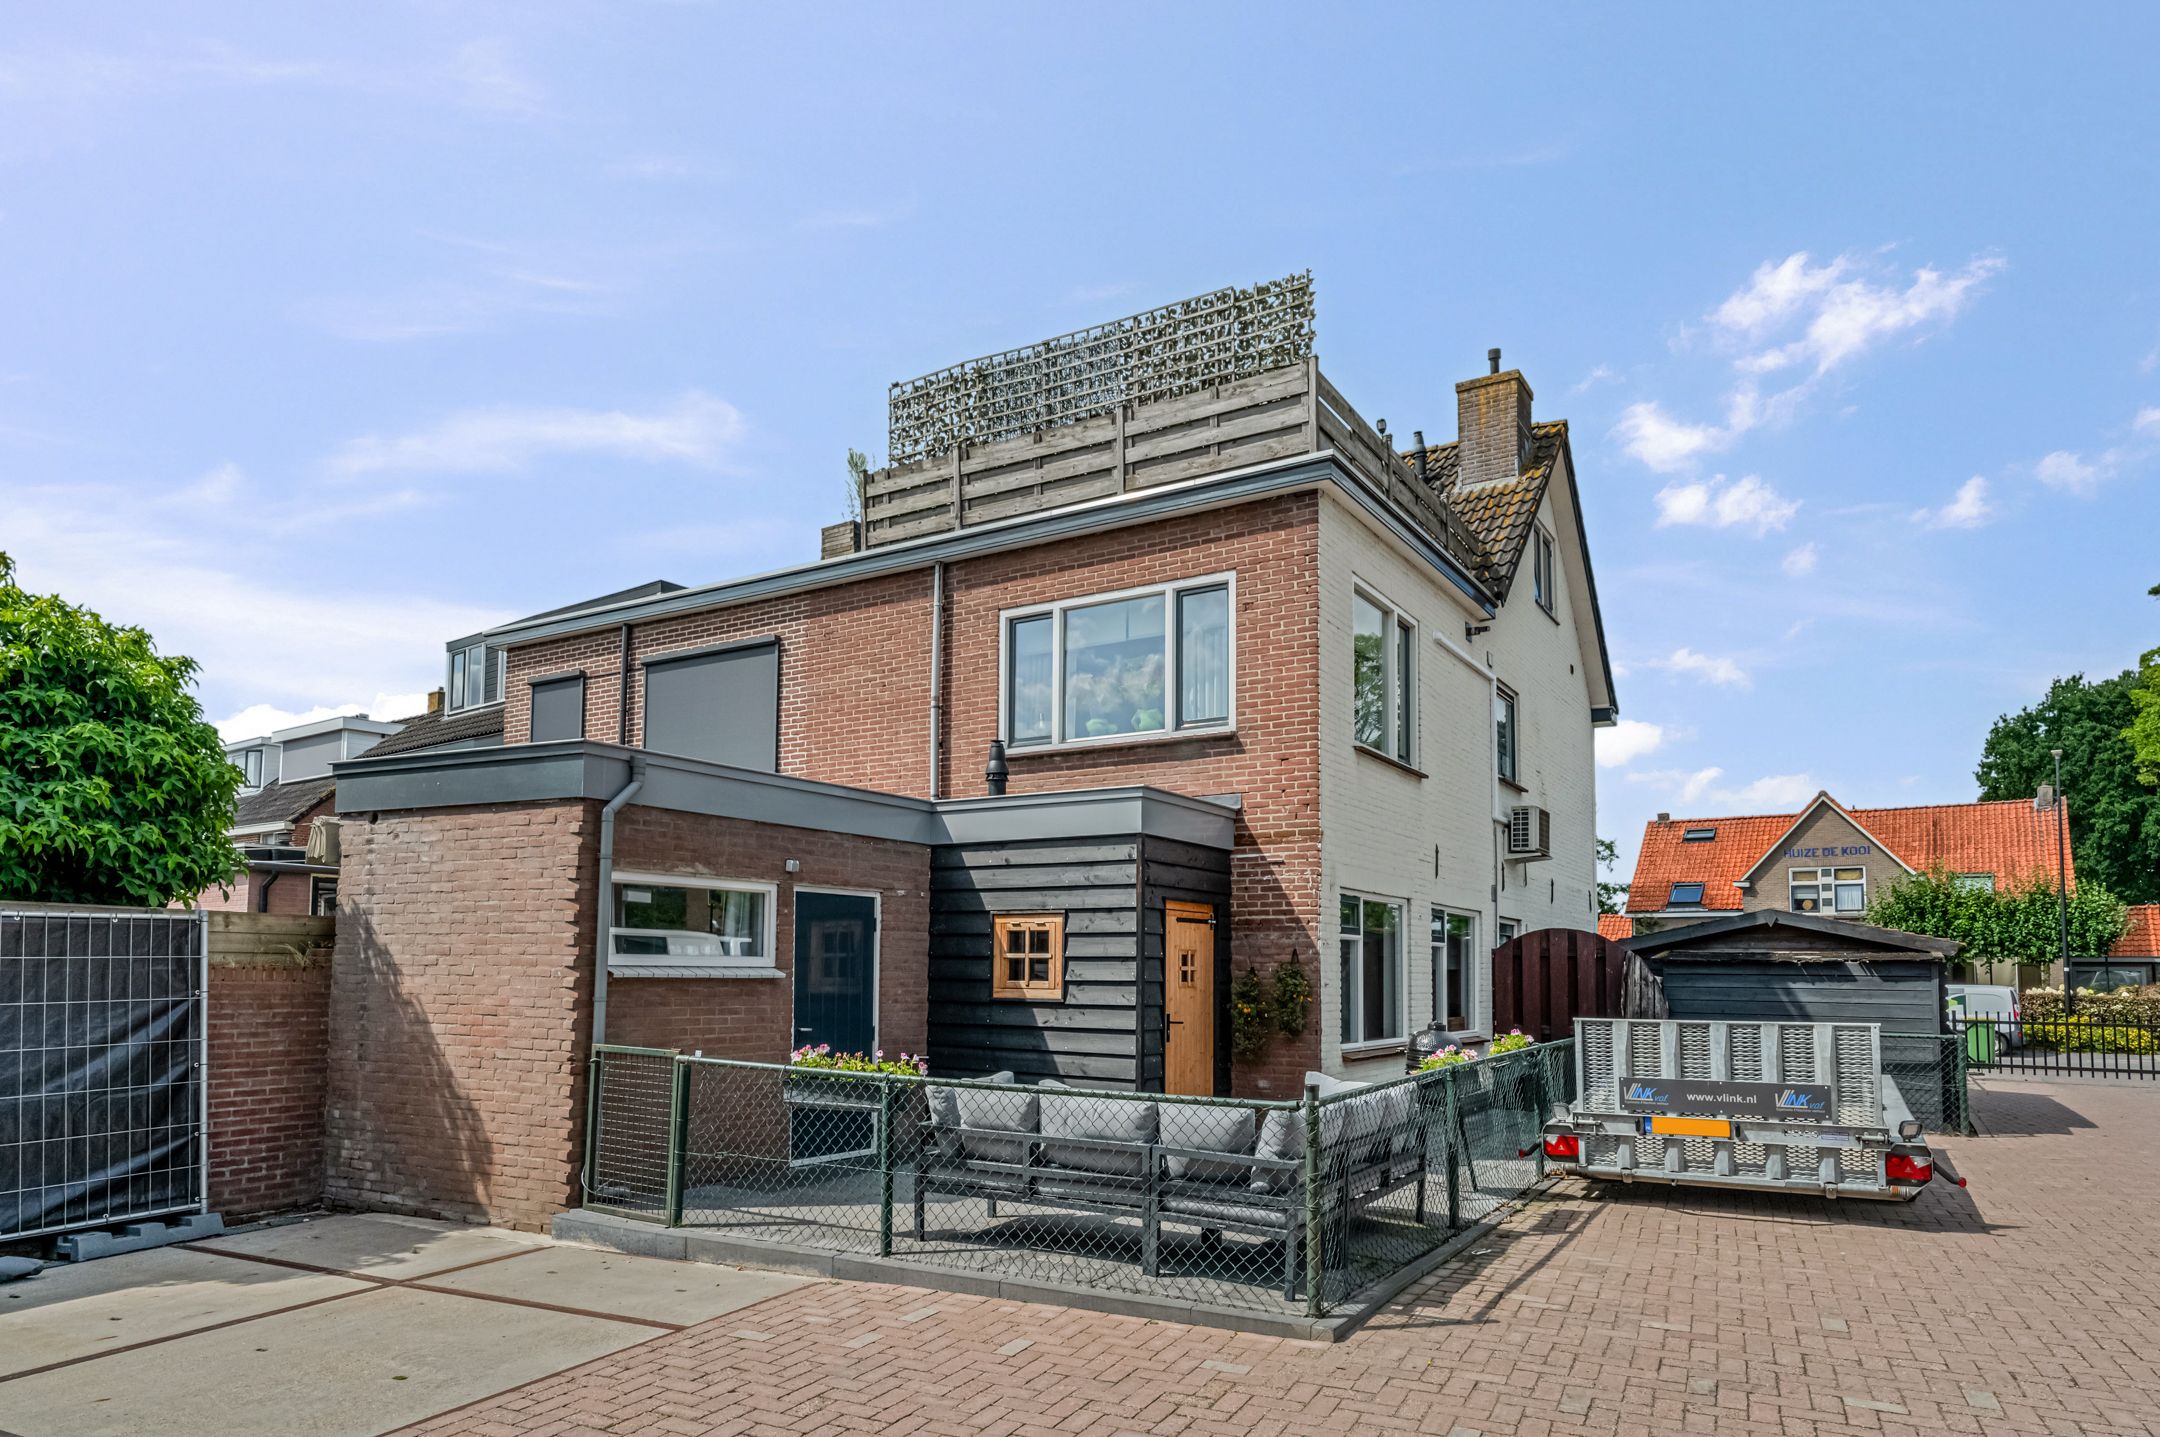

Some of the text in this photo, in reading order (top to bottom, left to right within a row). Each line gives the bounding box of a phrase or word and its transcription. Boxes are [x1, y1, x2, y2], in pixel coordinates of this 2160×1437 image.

[1783, 845, 1871, 858] HUIZE DE KOOI
[1686, 1093, 1757, 1104] www.vlink.nl
